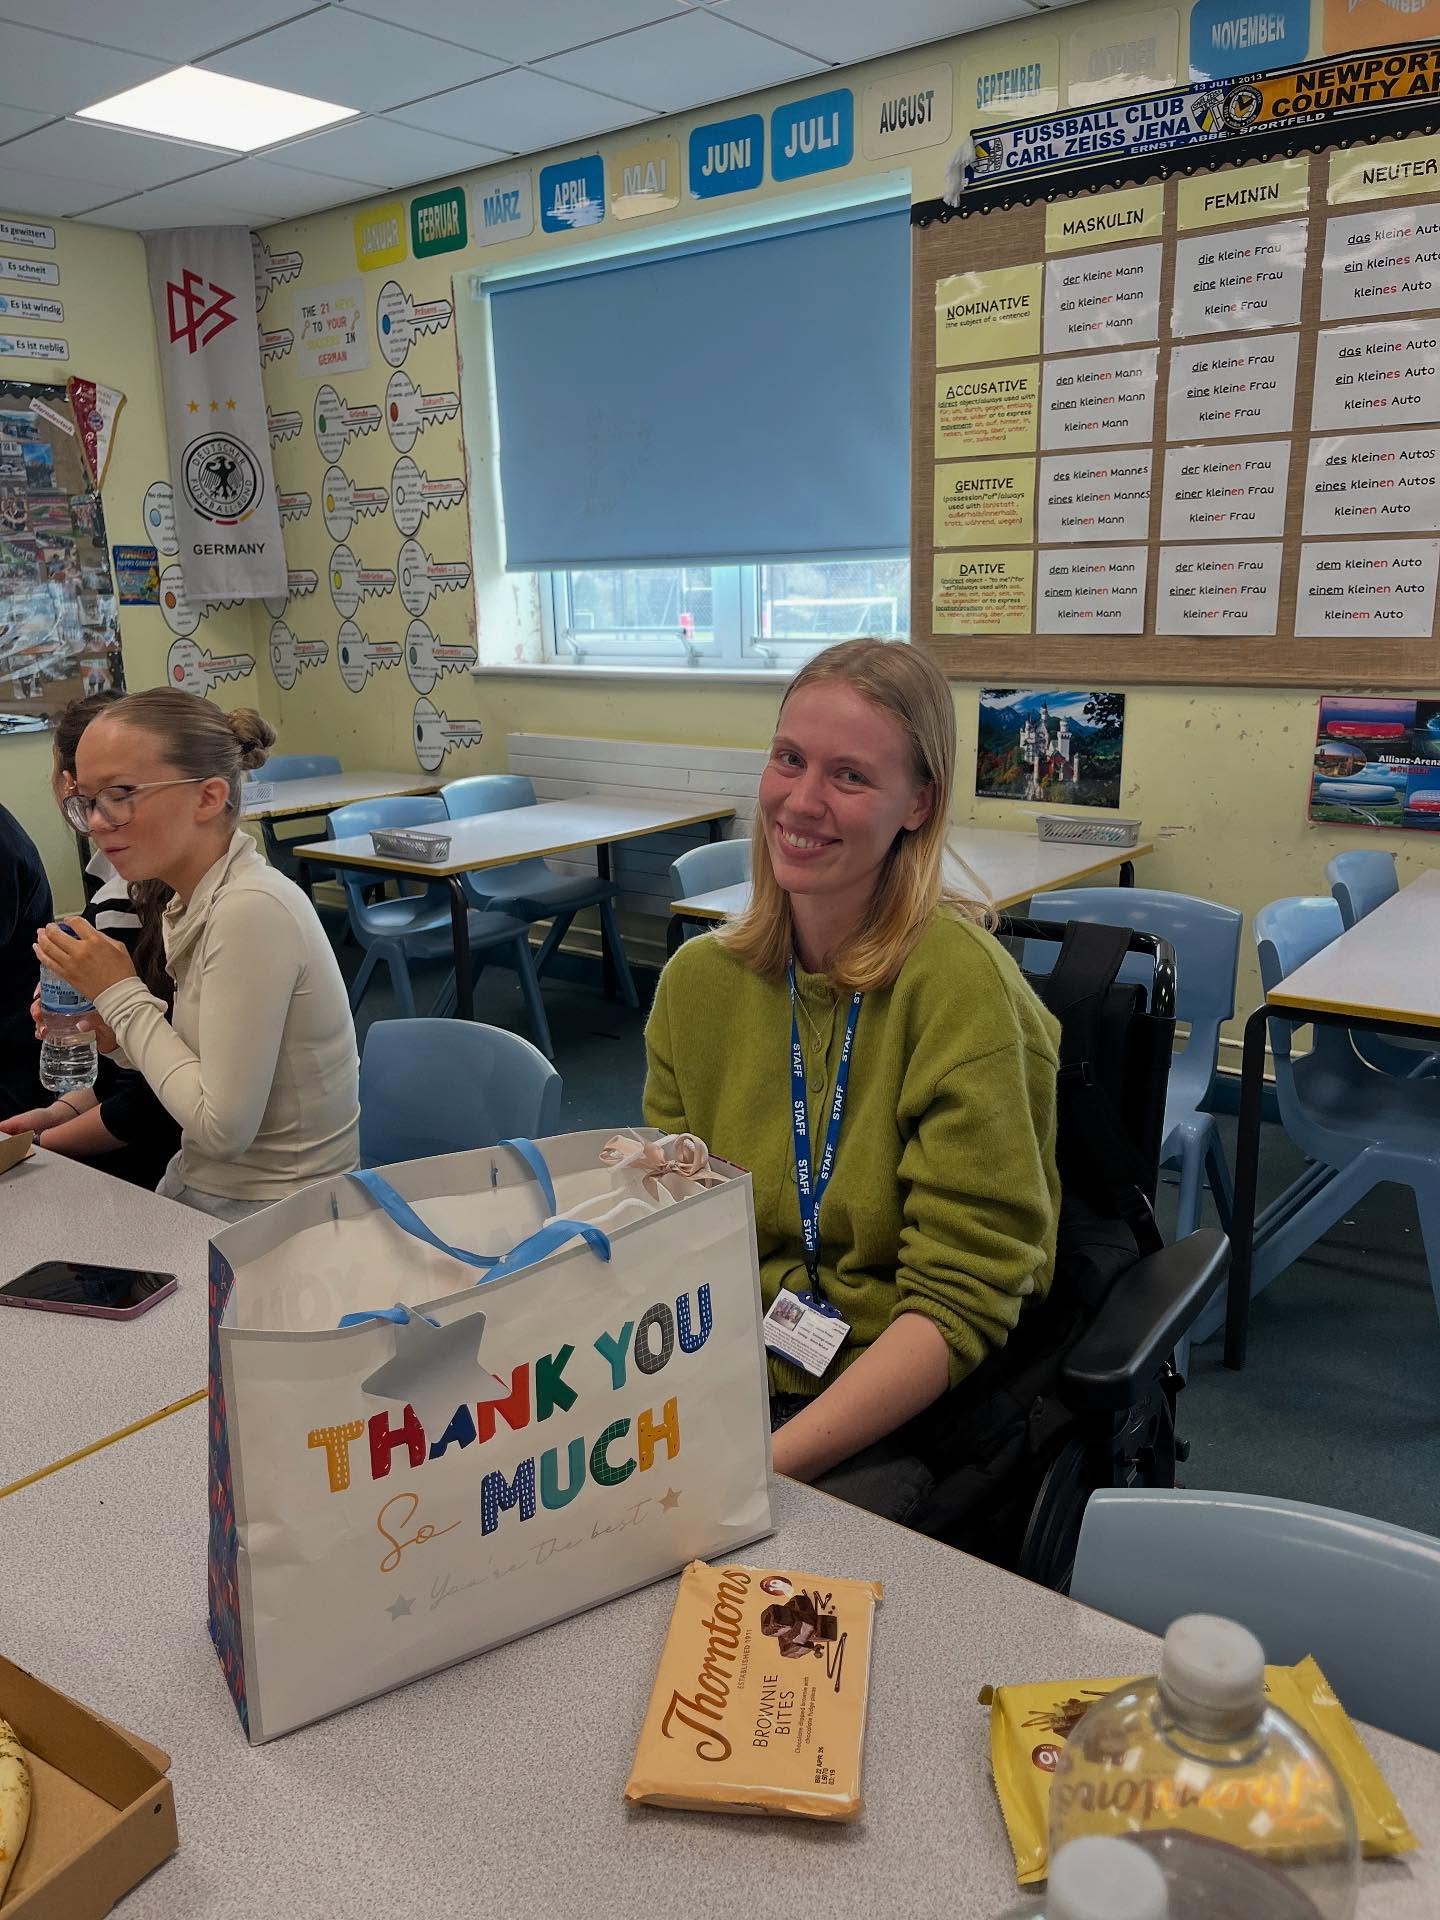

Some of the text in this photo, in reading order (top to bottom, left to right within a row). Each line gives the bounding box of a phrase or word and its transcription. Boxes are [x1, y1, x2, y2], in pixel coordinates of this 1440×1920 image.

[1211, 13, 1286, 50] NOVEMBER
[976, 63, 1041, 109] SEPTEMBER
[1193, 73, 1263, 91] 13 JULI 2013
[1271, 78, 1400, 117] COUNTY
[879, 90, 935, 134] AUGUST
[1013, 98, 1184, 148] FUSSBALL CLUB
[1189, 113, 1326, 144] ABBE SPORTFELD
[784, 112, 839, 158] JULI
[1006, 146, 1058, 168] CARL
[1064, 129, 1125, 157] ZEISS
[1132, 117, 1190, 142] JENA
[1131, 139, 1177, 154] ERNST
[701, 138, 751, 176] JUNI
[622, 159, 667, 196] MAI
[1362, 159, 1438, 184] NEUTER
[1204, 183, 1280, 211] FEMININ
[484, 188, 520, 227] MÄRZ
[417, 200, 460, 243] FEBRUAR
[1063, 209, 1144, 235] MASKULIN
[1, 225, 46, 239] Es gewittert
[362, 218, 400, 256] JANUAR
[8, 262, 16, 270] Es
[1062, 265, 1143, 286] der kleine Mann
[11, 301, 20, 309] Es
[22, 301, 32, 310] ist
[33, 304, 62, 316] windig
[947, 295, 1030, 320] NOMINATIVE
[1060, 290, 1143, 311] ein kleiner Mann
[302, 306, 317, 319] THE
[320, 303, 330, 314] 21
[312, 316, 347, 332] TO YOUR
[1068, 317, 1133, 333] kleiner Mann
[17, 341, 64, 353] Es ist neblig
[345, 332, 356, 344] IN
[1339, 339, 1436, 358] das kleine Auto
[318, 352, 348, 366] GERMAN
[1335, 366, 1435, 385] ein kleines Auto
[946, 379, 1028, 399] ACCUSATIVE
[1187, 380, 1276, 398] eine kleine Frau
[1344, 394, 1421, 409] kleines Auto
[1326, 449, 1435, 466] des kleinen Autos
[1053, 466, 1148, 481] des kleinen Mannes
[1181, 460, 1271, 475] der kleinen Frau
[955, 478, 1014, 493] GENITIVE
[1175, 485, 1274, 500] einer kleinen Frau
[1315, 476, 1435, 492] eines kleinen Autos
[1048, 490, 1150, 504] eines kleinen Mannes
[1190, 511, 1255, 523] kleiner Frau
[1335, 503, 1411, 516] kleinen Auto
[1061, 514, 1125, 526] kleinen Mann
[193, 543, 265, 555] GERMANY
[959, 564, 1005, 576] DATIVE
[1049, 562, 1135, 575] dem kleinen Mann
[1175, 560, 1264, 573] der kleinen Frau
[1316, 557, 1422, 570] dem kleinen Auto
[1044, 585, 1137, 597] einem kleinen Mann
[1169, 584, 1267, 597] einer kleinen Frau
[1309, 583, 1425, 595] einem kleinen Auto
[1058, 607, 1121, 618] kleinem Mann
[1184, 609, 1248, 619] kleiner Frau
[1325, 609, 1403, 620] kleinem Auto
[841, 1026, 853, 1063] STAFF
[792, 1042, 804, 1078] STAFF
[832, 1084, 844, 1121] STAFF
[794, 1100, 806, 1136] STAFF
[820, 1142, 834, 1180] STAFF
[798, 1158, 810, 1195] STAFF
[307, 1343, 579, 1494] THANK
[593, 1282, 714, 1391] YOU
[481, 1396, 681, 1537] MUCH
[590, 1496, 655, 1541] best
[376, 1492, 463, 1573] So
[661, 1569, 752, 1762] Thorntons
[738, 1645, 750, 1689] ESTABLISHED
[753, 1674, 779, 1748] BROWNIE
[775, 1690, 795, 1735] BITES
